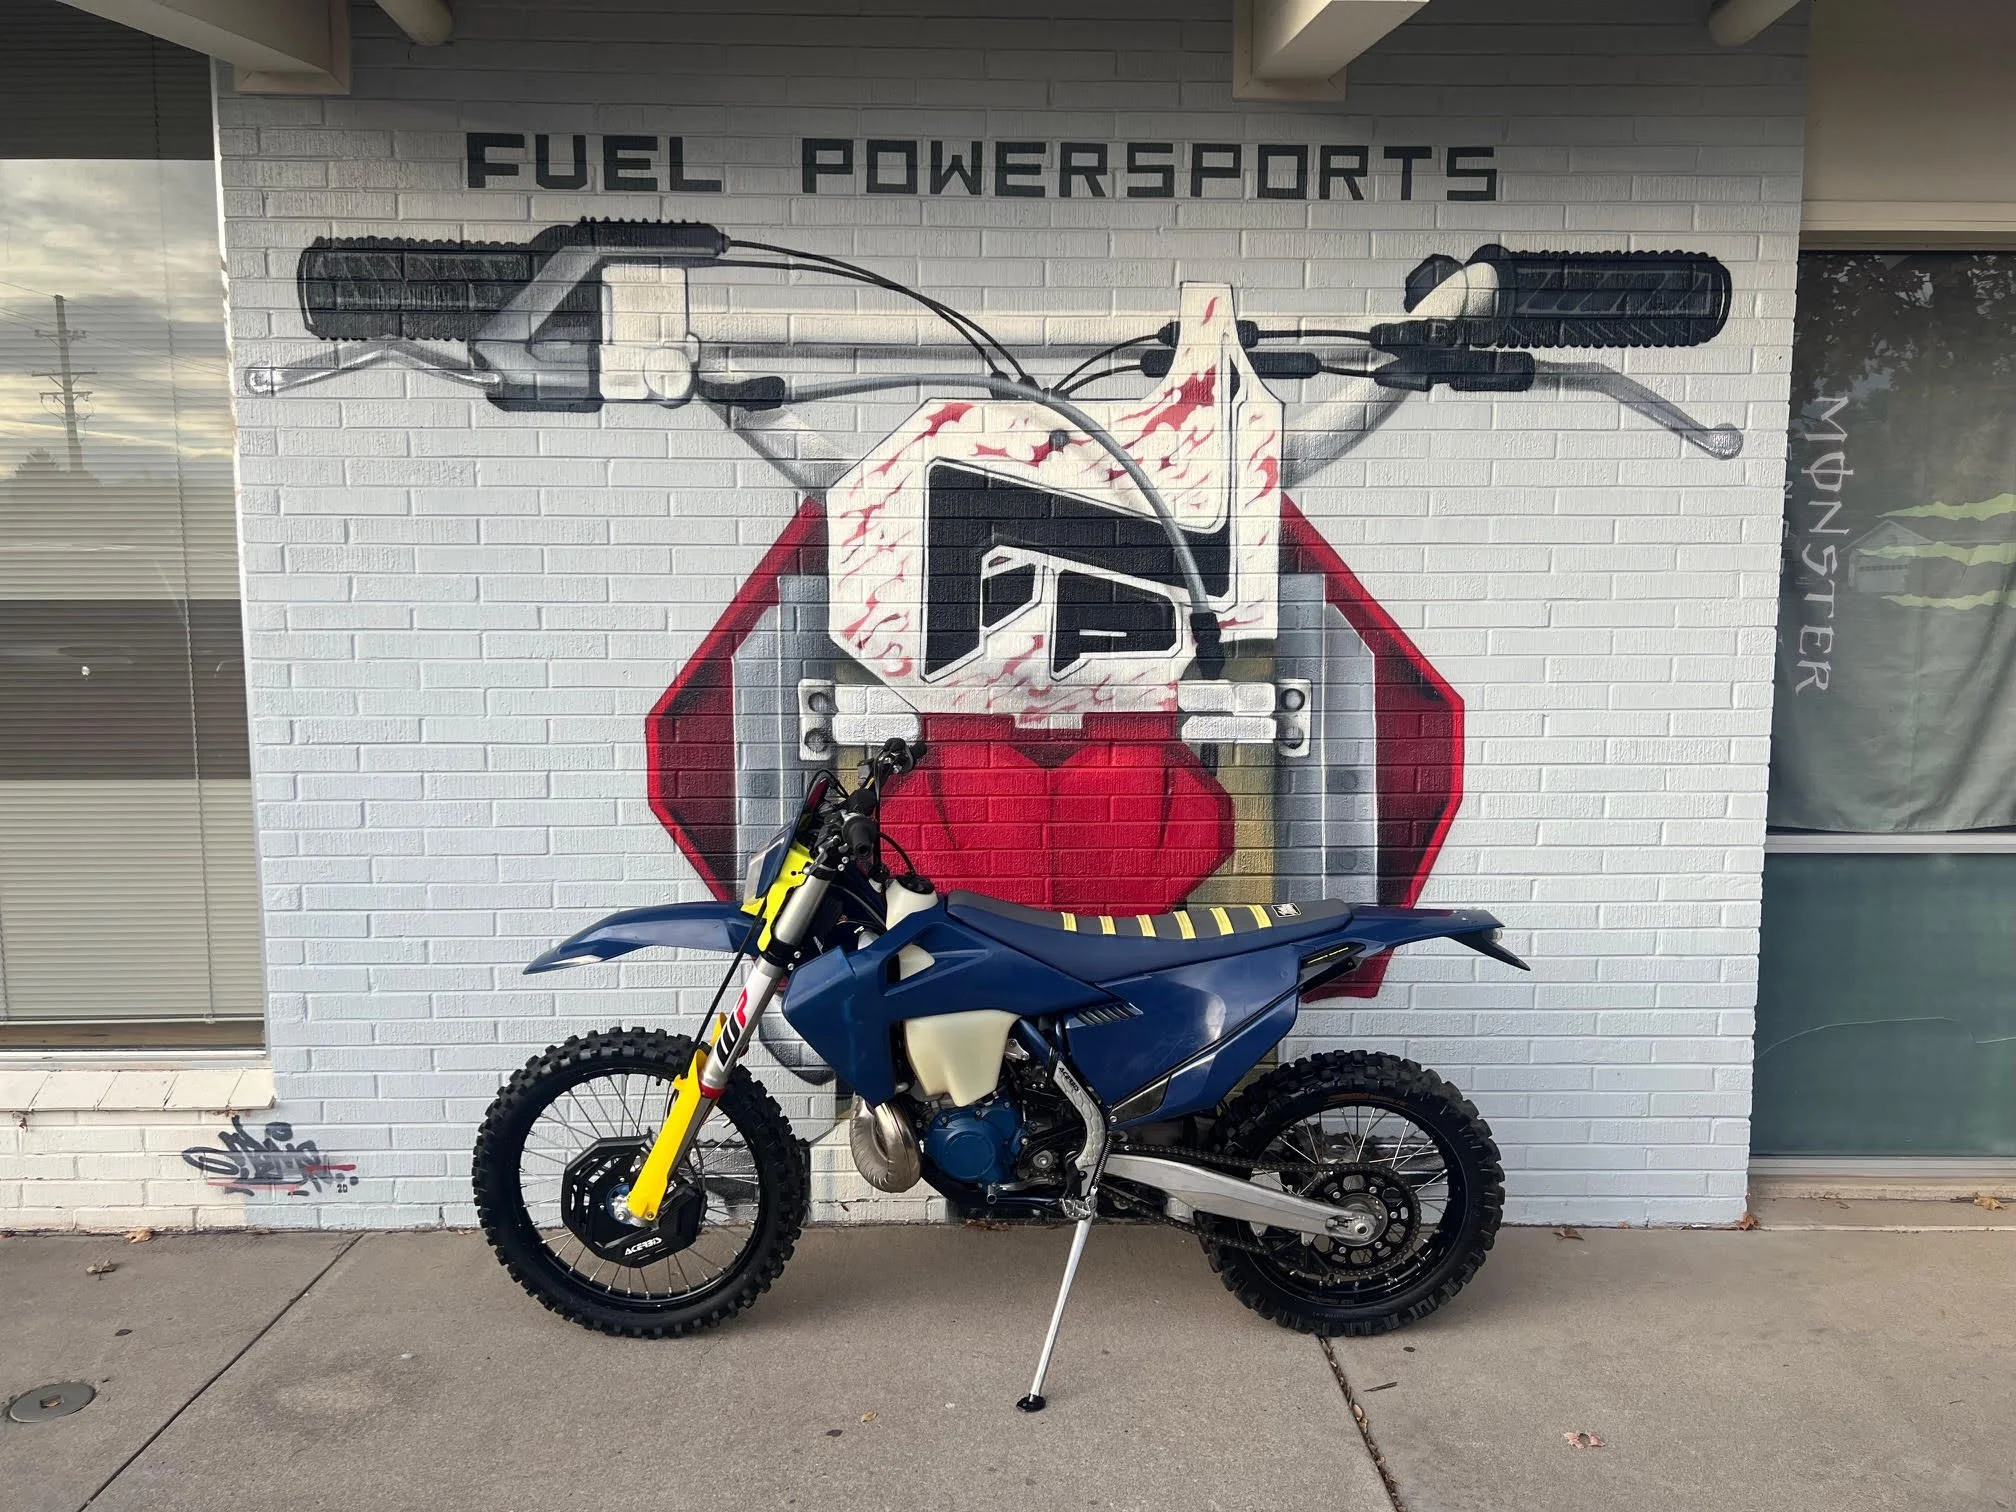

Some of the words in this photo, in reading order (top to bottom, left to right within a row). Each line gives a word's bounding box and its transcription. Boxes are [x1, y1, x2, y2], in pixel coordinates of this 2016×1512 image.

[466, 132, 722, 192] FUEL
[802, 138, 1498, 201] POWERSPORTS
[1795, 396, 1854, 696] MONSTER
[624, 1236, 663, 1256] ACERBIS
